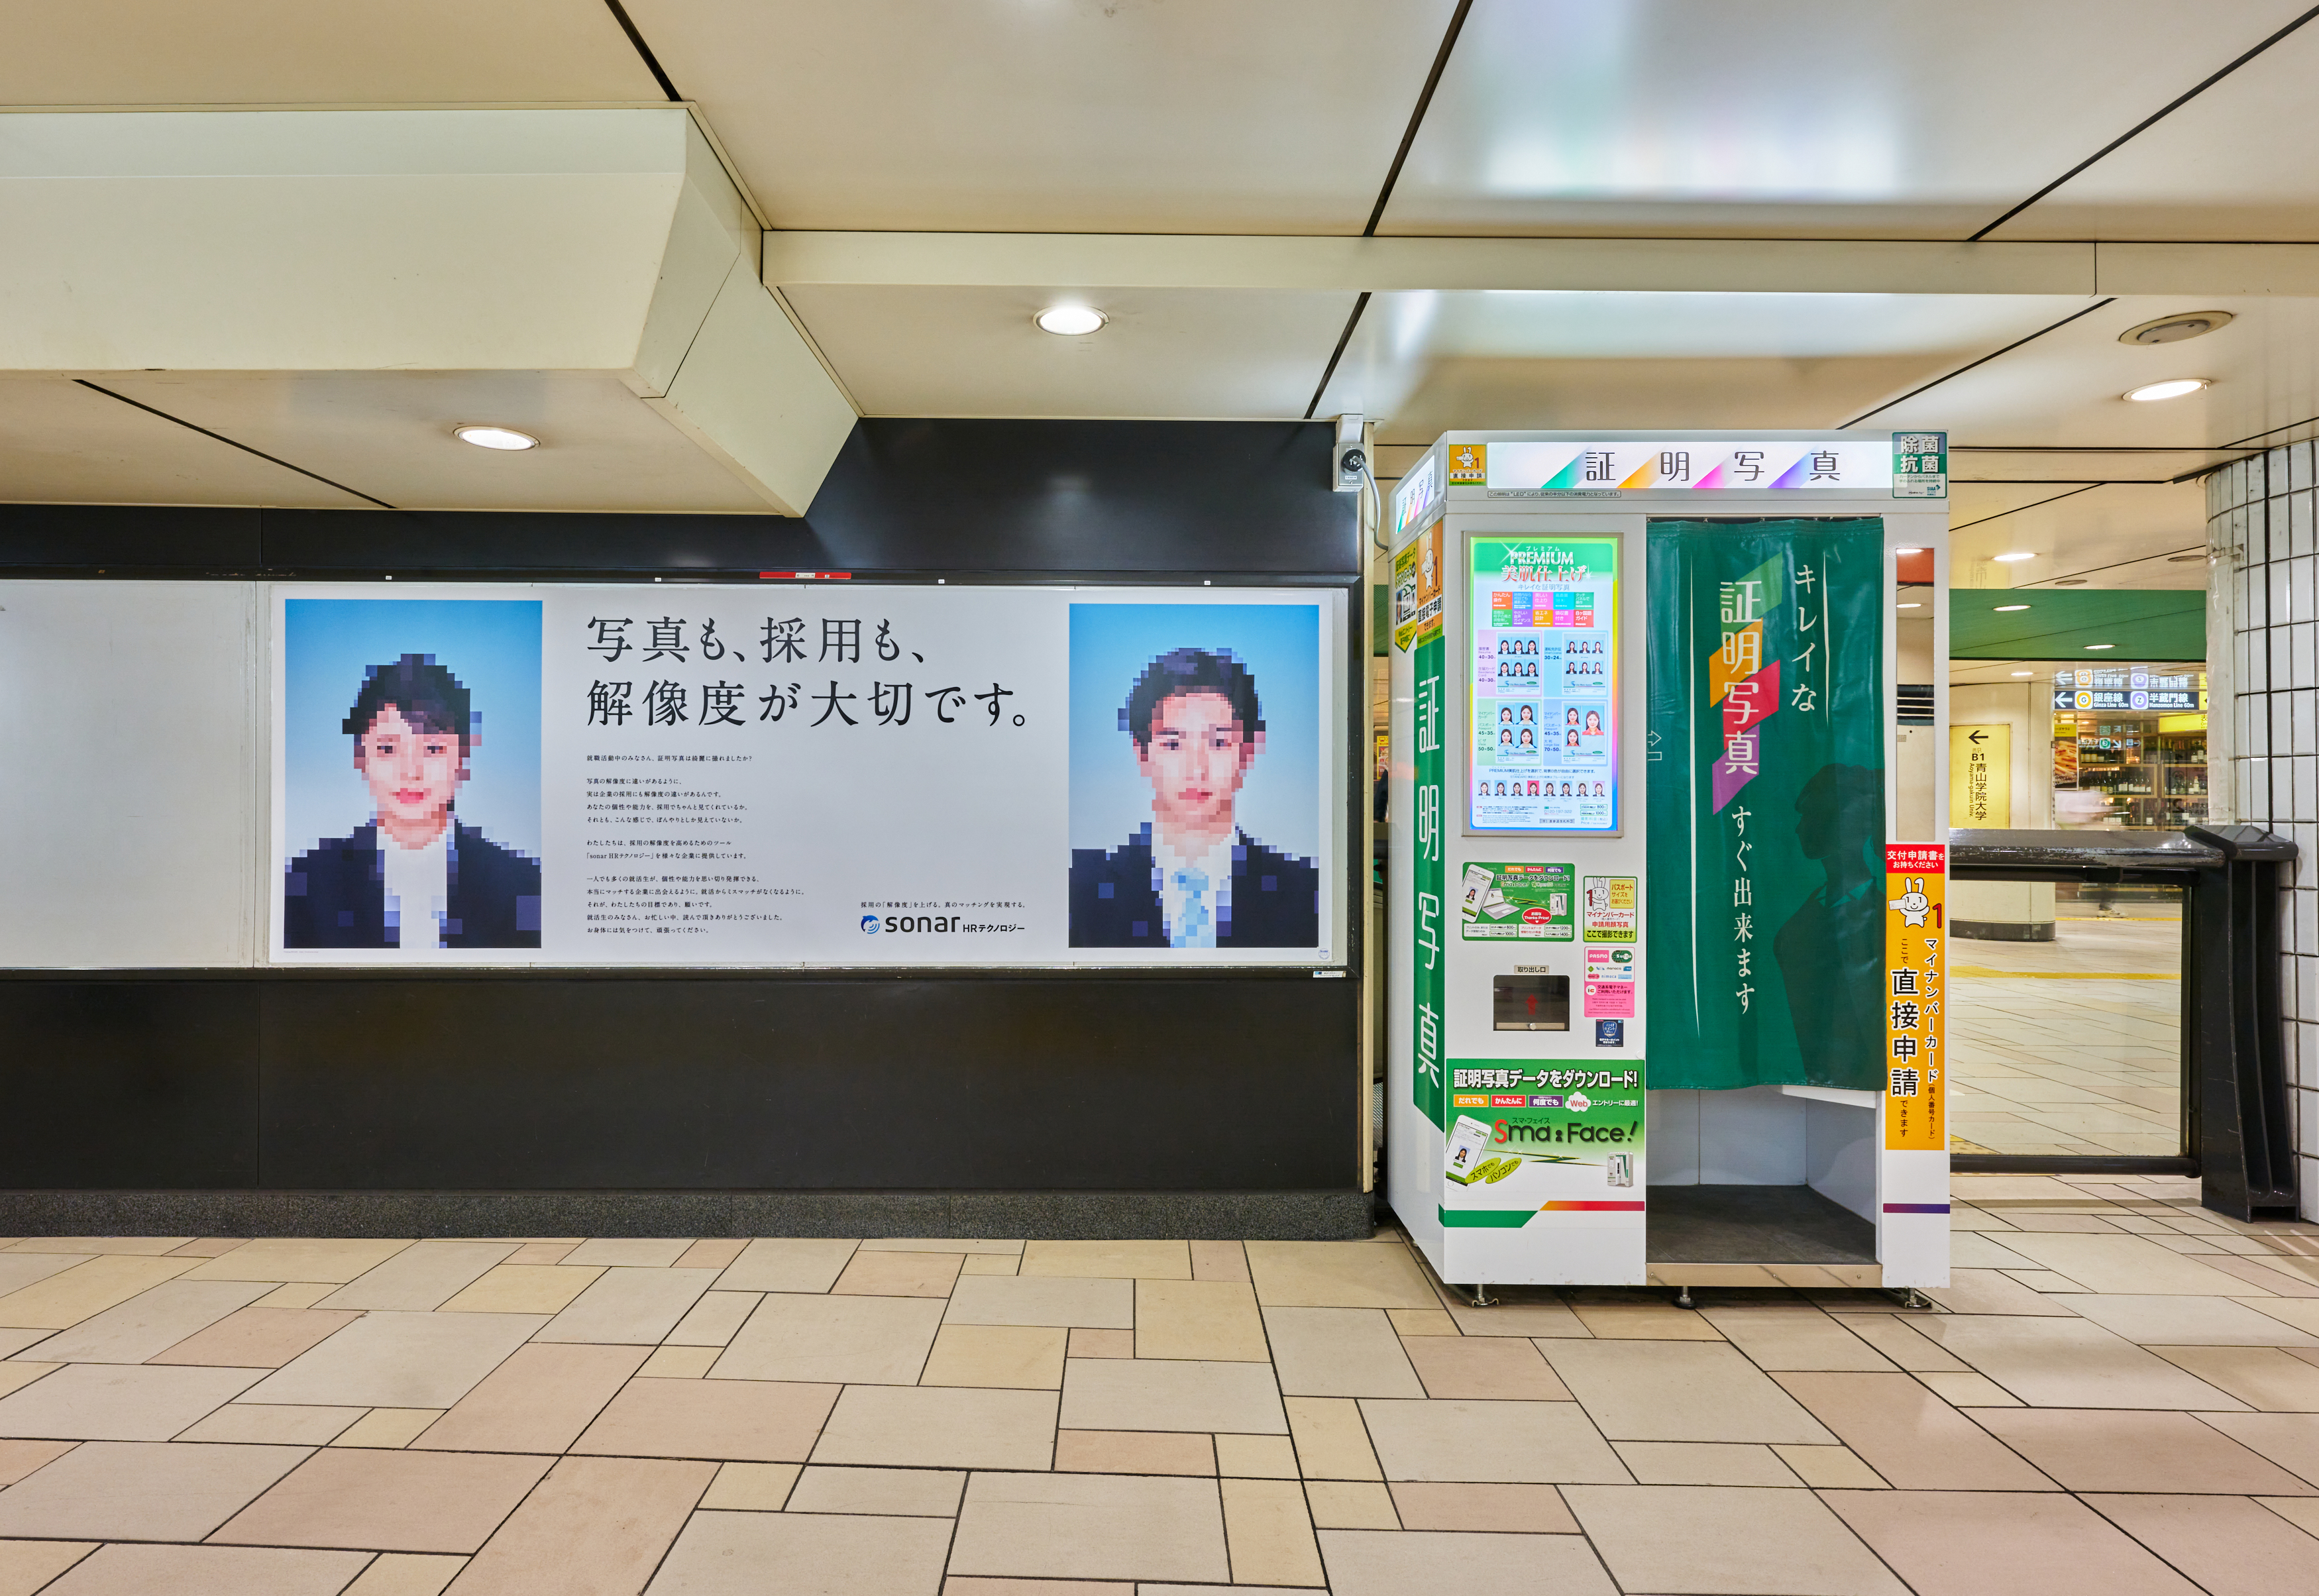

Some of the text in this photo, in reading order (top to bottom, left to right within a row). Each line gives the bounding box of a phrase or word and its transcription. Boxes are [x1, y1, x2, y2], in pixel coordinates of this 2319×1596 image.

[1901, 436, 1939, 453] 除菌
[1586, 451, 1841, 482] 証明写真
[1900, 455, 1939, 473] 抗菌
[1402, 470, 1433, 516] 証明写真
[1510, 551, 1574, 564] PREMIUM
[1501, 565, 1586, 582] 美肌仕上げ
[587, 616, 924, 663] 写真も、採用も、
[1792, 564, 1817, 712] キレイな
[1720, 580, 1762, 775] 証明写真
[587, 679, 1025, 727] 解像度が大切です。
[2094, 693, 2123, 702] 銀座線
[2149, 693, 2188, 702] 半蔵門線
[1975, 763, 1987, 821] 青山学院大学
[1887, 851, 1945, 861] 交付申請書を
[1892, 861, 1938, 869] お持ちください
[1418, 675, 1440, 1089] 証明写真
[1731, 806, 1755, 1015] すぐ出来ます
[885, 916, 1025, 933] sonar HRテクノロジー
[1923, 937, 1939, 1083] マイナンバーカード
[1890, 968, 1919, 1097] 直接申請
[1454, 1069, 1638, 1089] 証明写真データをダウンロード！
[1900, 1100, 1909, 1138] できます
[1470, 1162, 1495, 1181] スマホでも
[1490, 1160, 1519, 1182] パソコンでも
